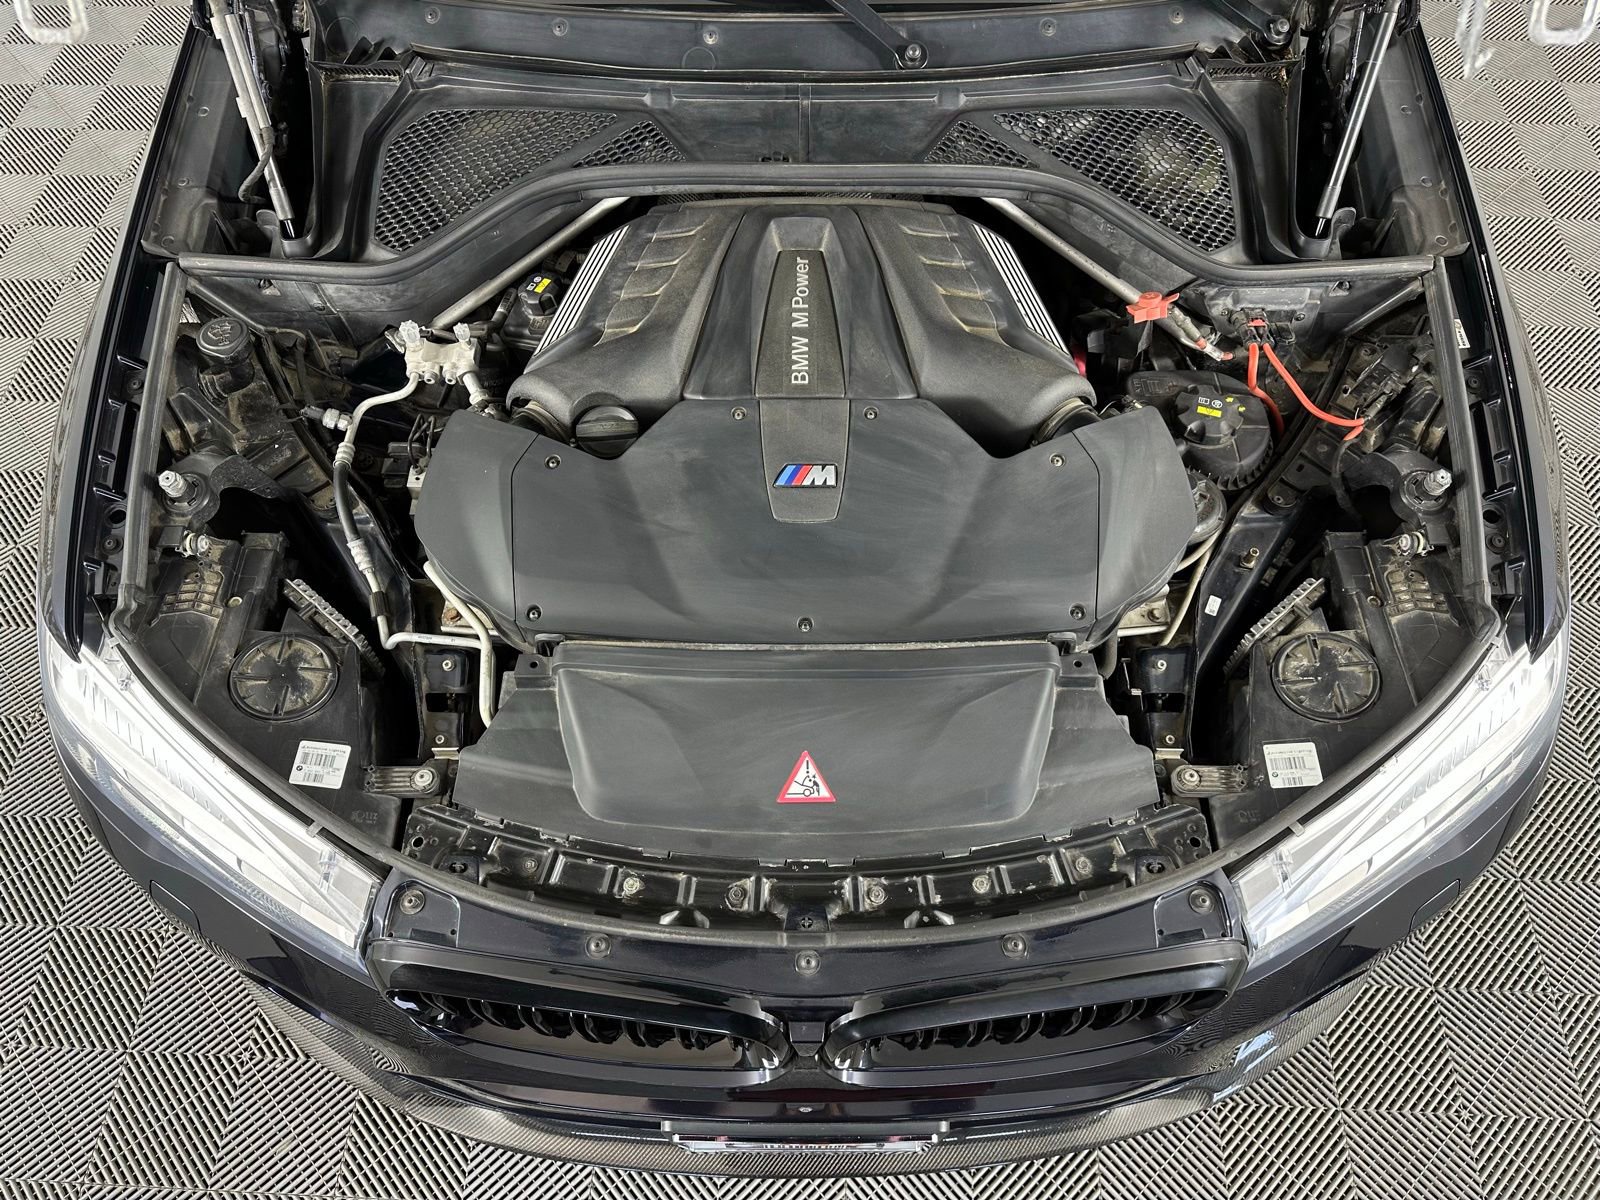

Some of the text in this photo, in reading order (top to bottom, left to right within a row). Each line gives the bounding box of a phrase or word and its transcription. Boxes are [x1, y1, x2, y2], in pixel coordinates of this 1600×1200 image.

[791, 256, 809, 384] BMW M Power
